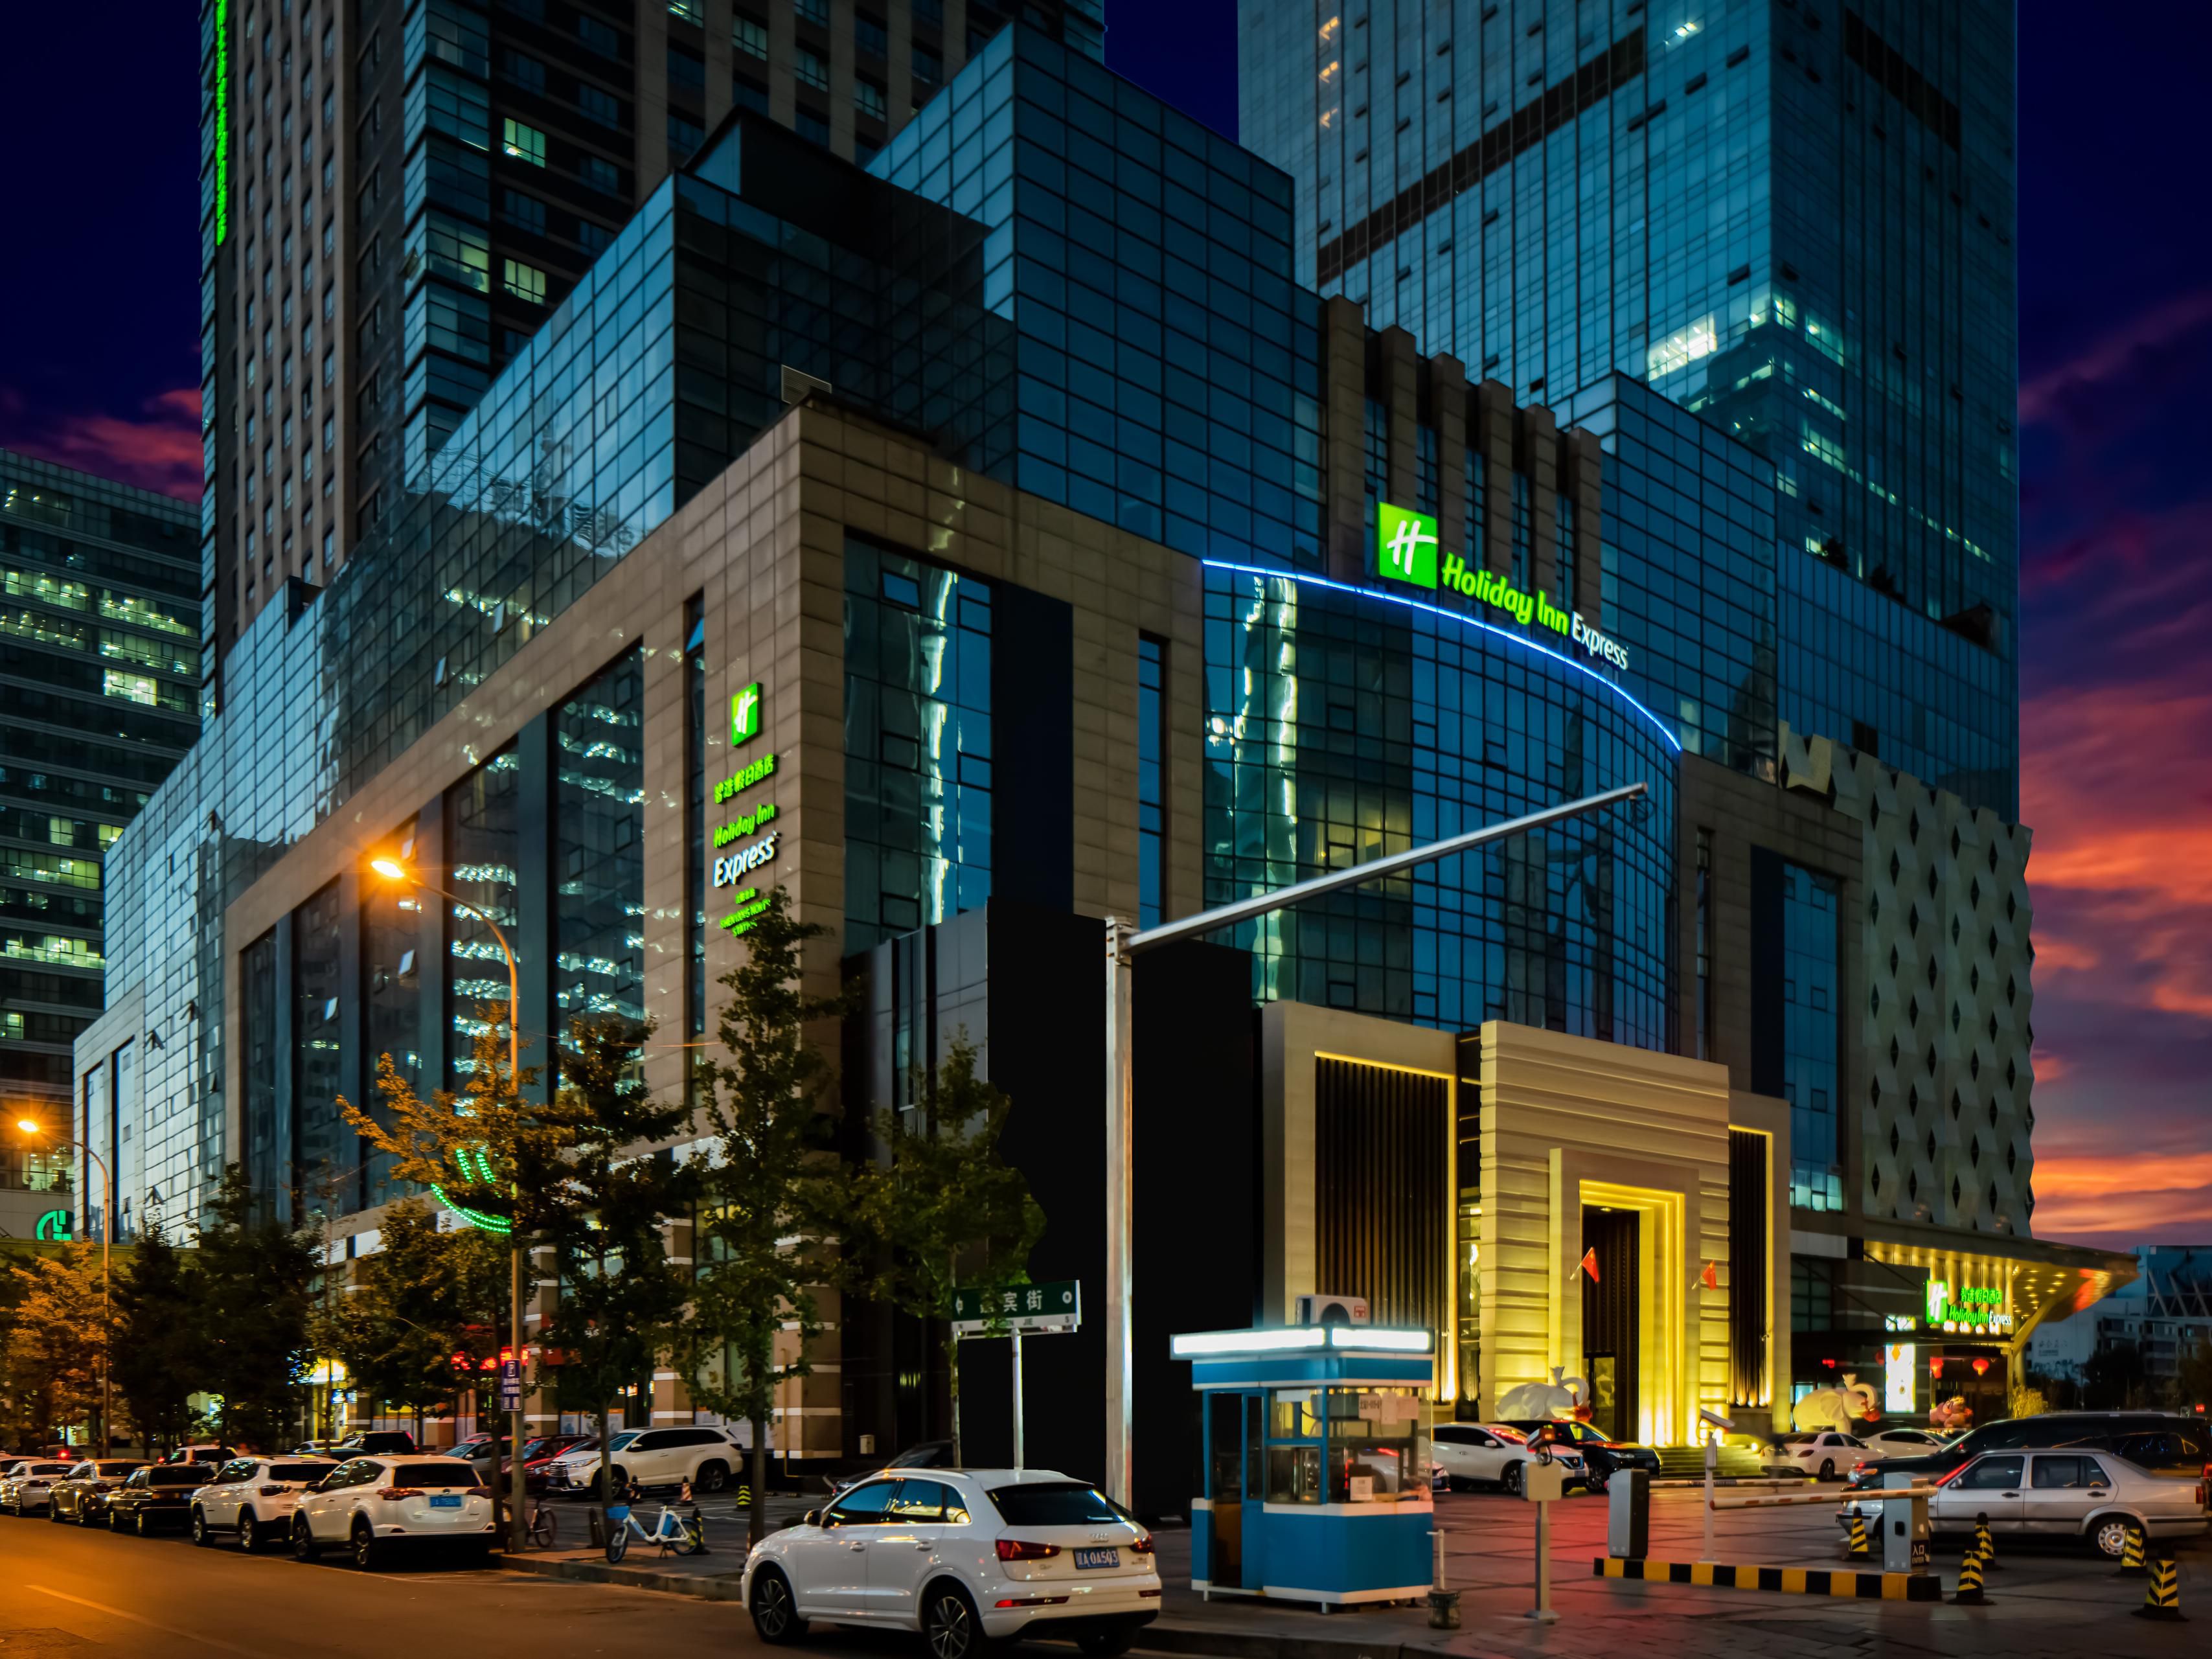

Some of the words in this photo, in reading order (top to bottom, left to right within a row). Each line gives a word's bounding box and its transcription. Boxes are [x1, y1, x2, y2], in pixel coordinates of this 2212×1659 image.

[1442, 552, 1533, 626] Holiday
[1538, 589, 1569, 636] Inn
[1571, 611, 1628, 670] Express
[713, 814, 755, 849] Holiday
[756, 803, 775, 825] Inn
[713, 834, 775, 887] Express
[1949, 1305, 1977, 1327] Holiday
[1977, 1307, 1989, 1324] Inn
[1989, 1309, 2012, 1326] Express
[1912, 1544, 1924, 1556] 入口
